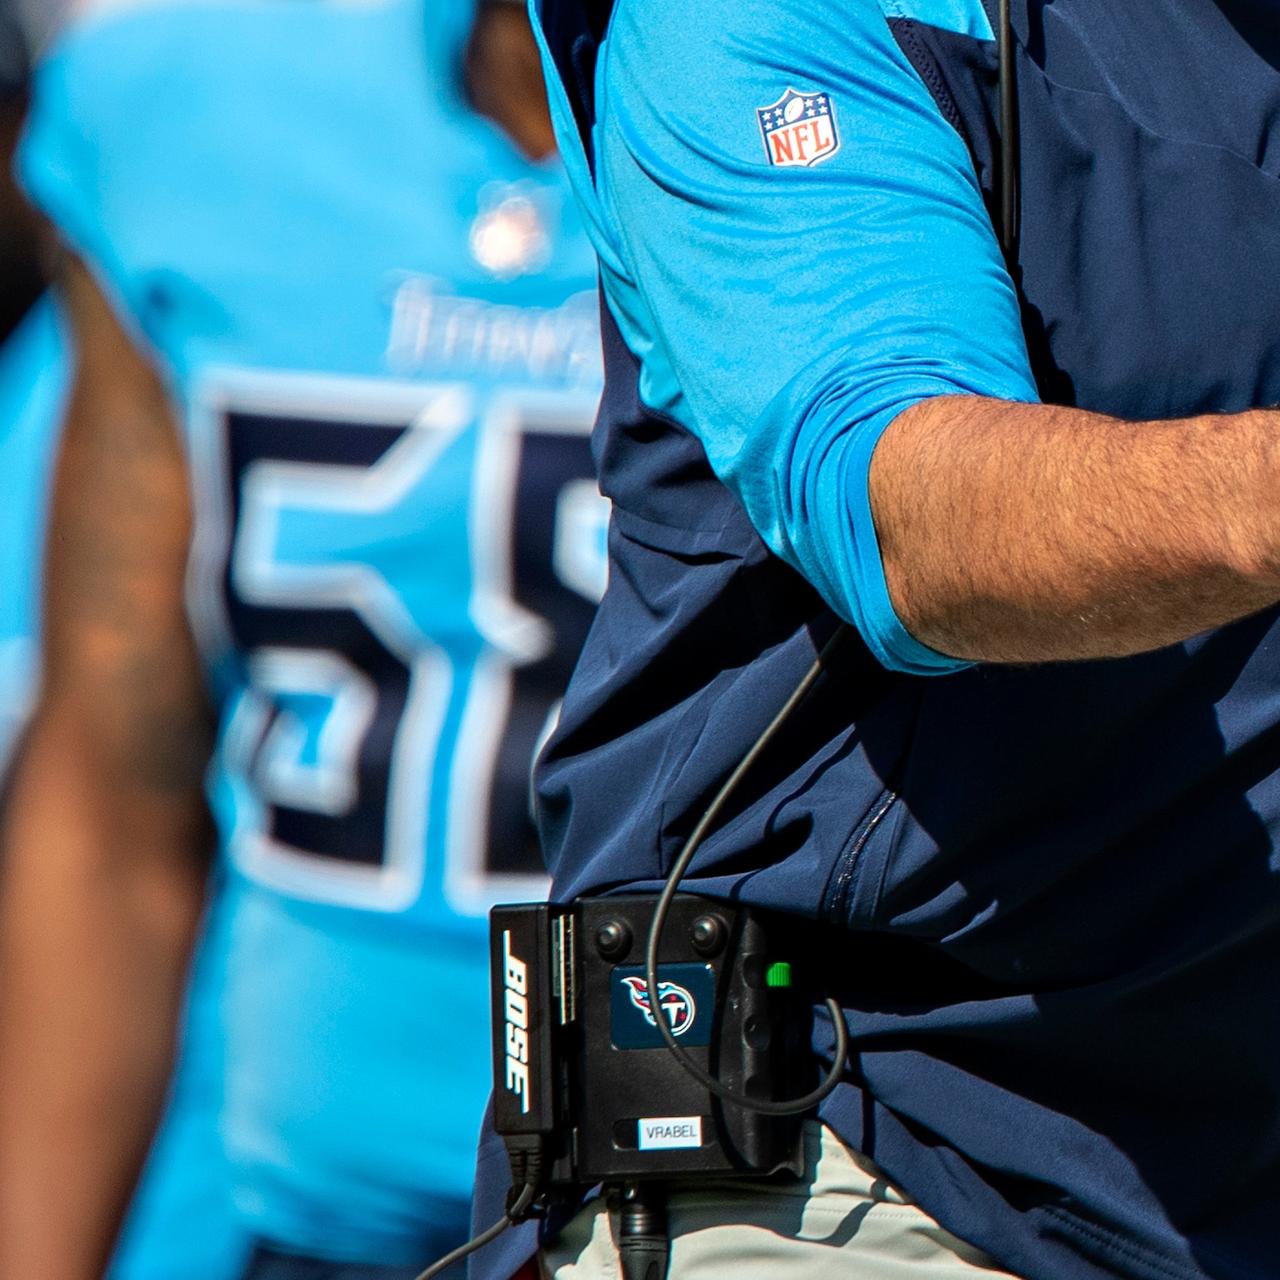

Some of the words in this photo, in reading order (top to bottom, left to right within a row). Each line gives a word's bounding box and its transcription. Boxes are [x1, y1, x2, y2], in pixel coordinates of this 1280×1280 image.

[770, 120, 831, 164] NFL
[503, 928, 530, 1115] BOSE
[646, 1124, 698, 1139] VRABEL
